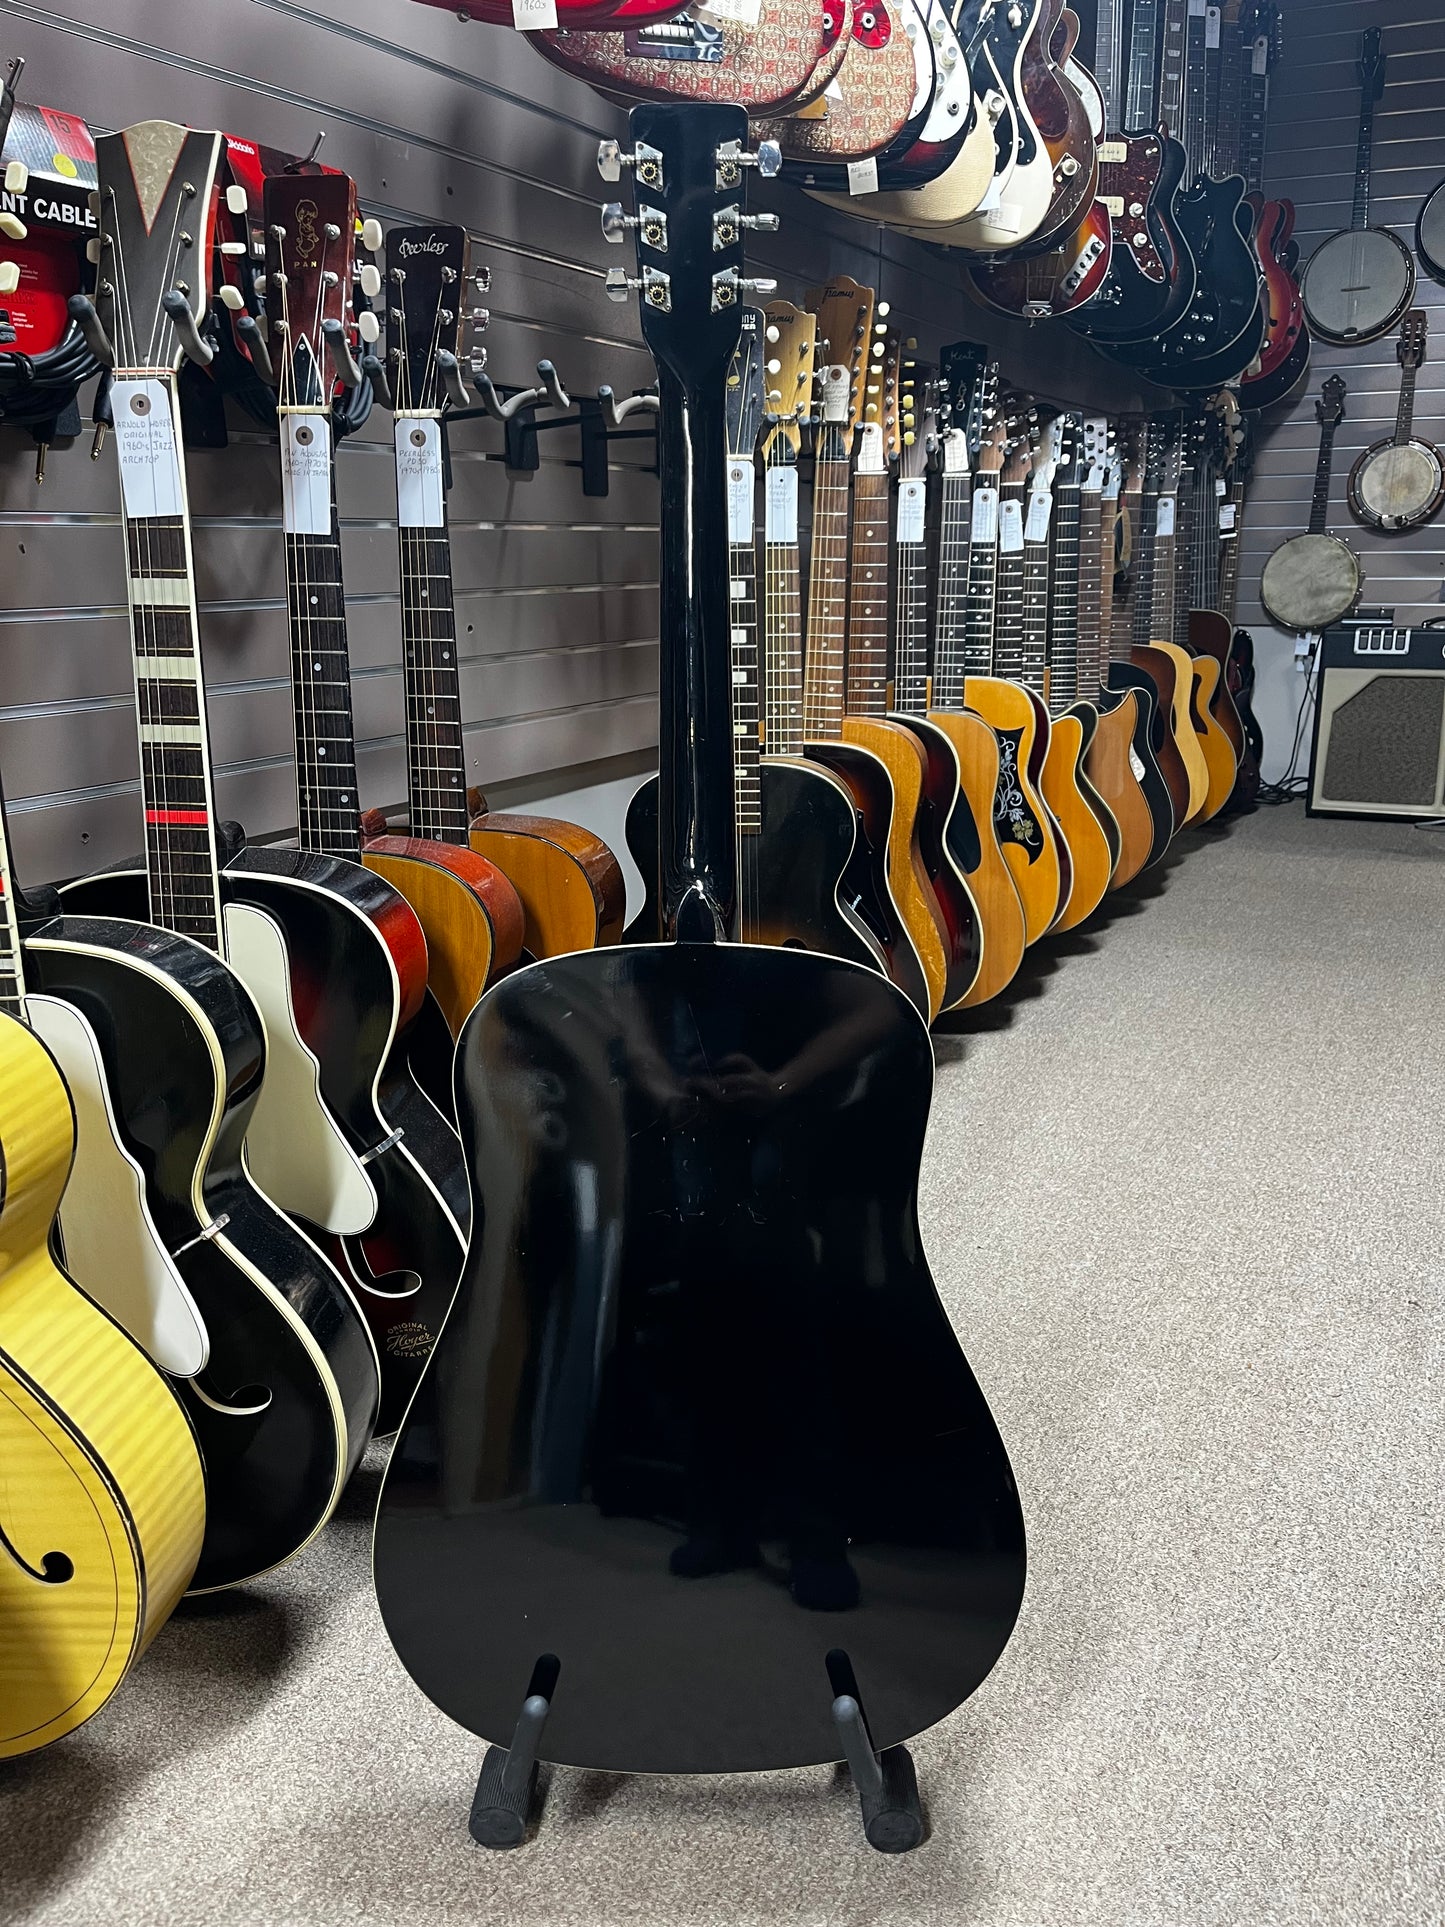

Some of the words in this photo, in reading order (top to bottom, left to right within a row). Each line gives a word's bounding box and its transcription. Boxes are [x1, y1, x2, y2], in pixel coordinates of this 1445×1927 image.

[0, 190, 28, 214] NT
[33, 198, 98, 229] CABLE
[398, 233, 449, 259] Peerless
[293, 260, 318, 269] PAN
[822, 286, 855, 304] Framus
[117, 420, 147, 429] ARNOLD
[122, 454, 160, 465] ARCHTOP
[399, 449, 436, 457] PEERLESS
[387, 1322, 428, 1335] ORIGINAL
[386, 1332, 436, 1352] Hoyer
